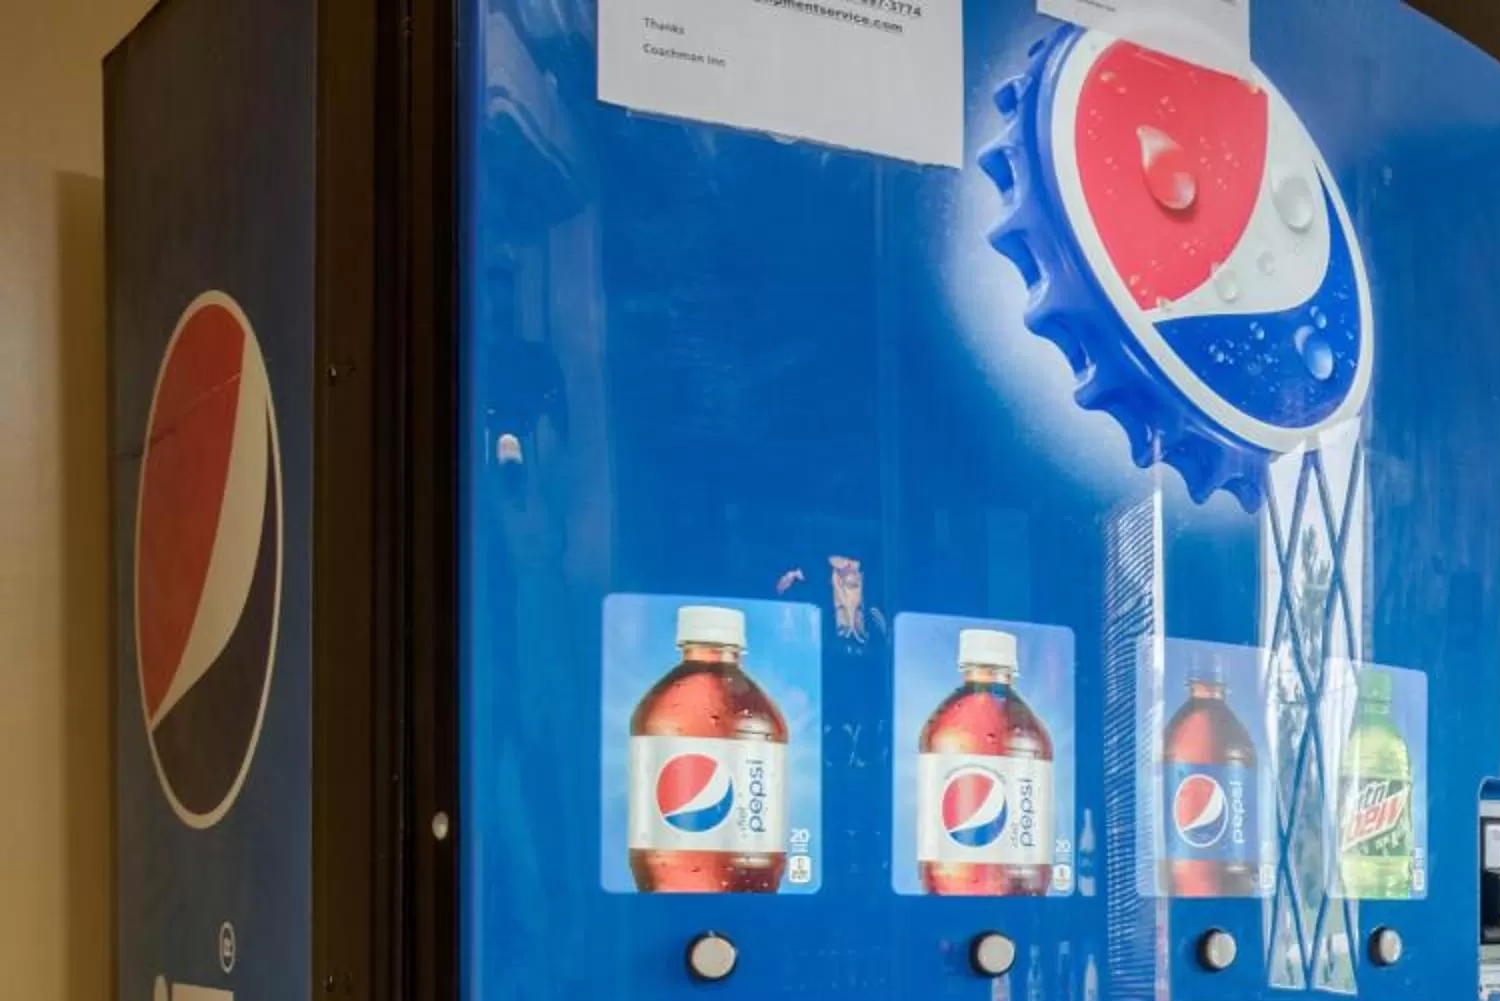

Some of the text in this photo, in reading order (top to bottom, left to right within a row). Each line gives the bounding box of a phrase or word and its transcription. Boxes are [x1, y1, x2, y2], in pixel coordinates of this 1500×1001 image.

[642, 17, 685, 35] Thanks
[642, 43, 726, 67] Coachman Inn
[745, 759, 766, 833] pepsi
[1017, 778, 1036, 847] pepsi
